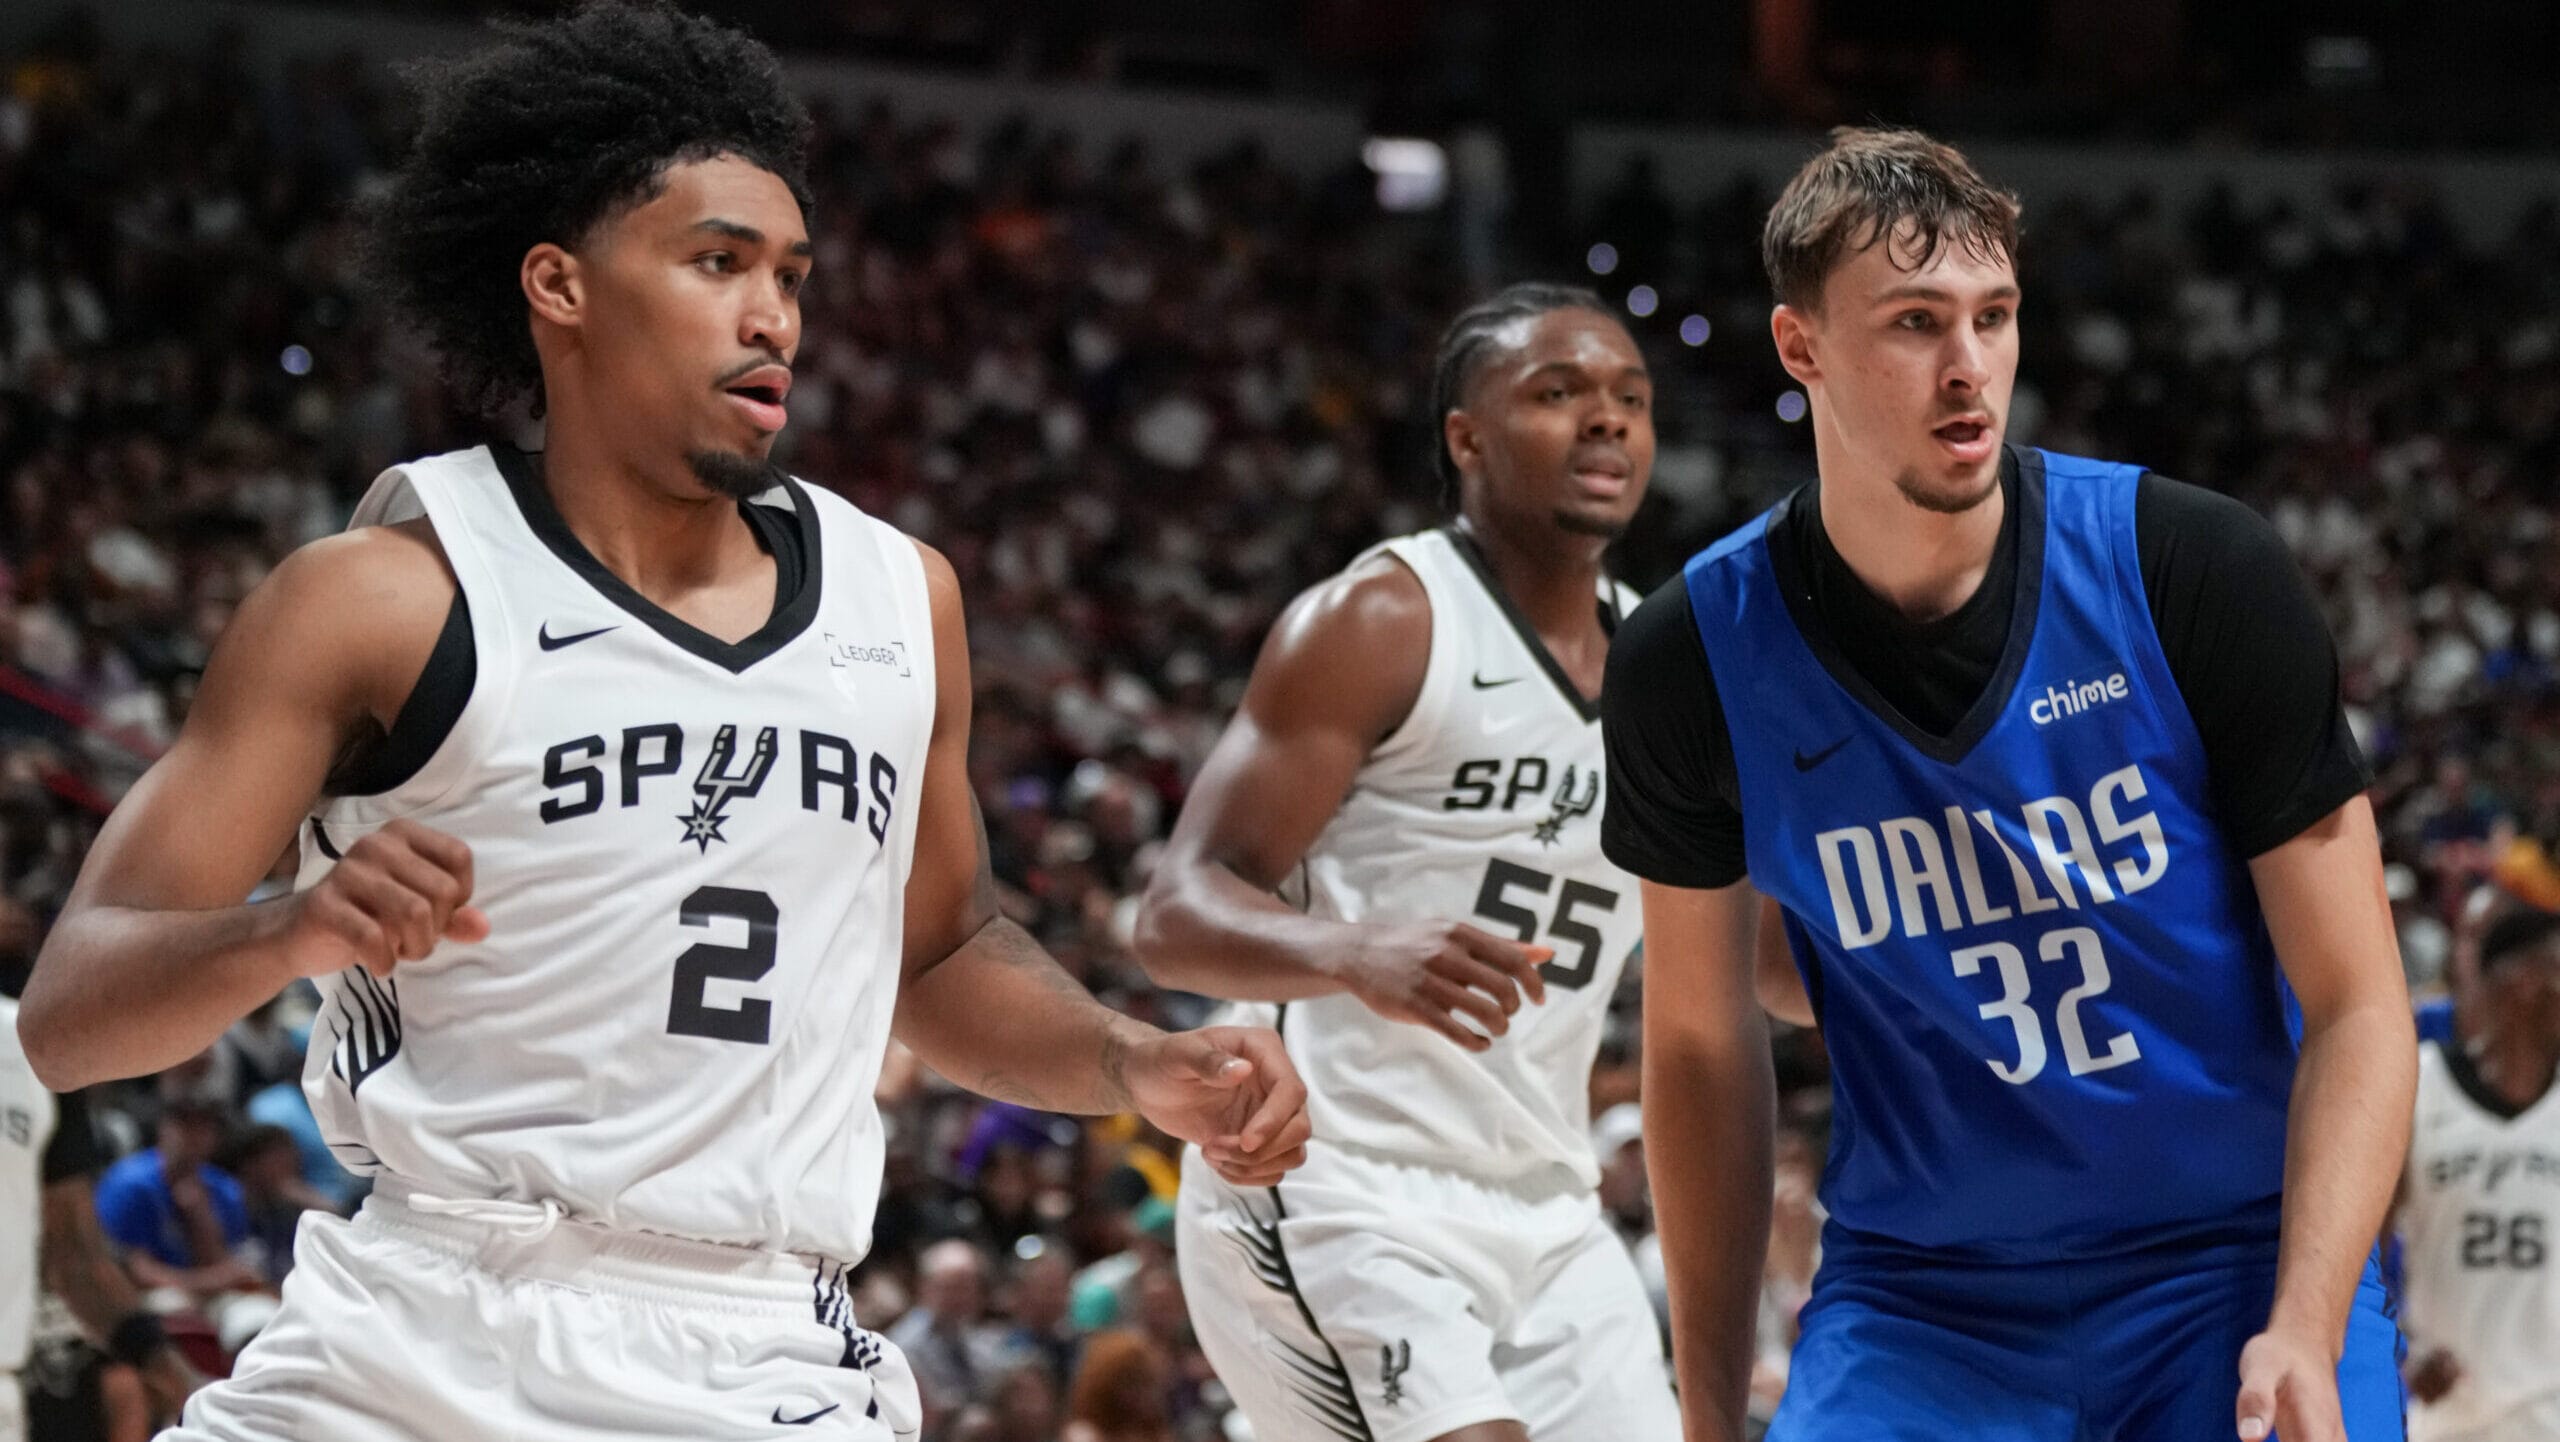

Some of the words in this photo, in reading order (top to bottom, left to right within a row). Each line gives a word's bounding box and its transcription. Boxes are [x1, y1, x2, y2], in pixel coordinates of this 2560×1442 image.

[838, 644, 898, 666] LEDGER
[2030, 672, 2128, 725] chime
[540, 722, 897, 854] SPURS
[1444, 758, 1599, 849] SPU
[1815, 764, 2169, 950] DALLAS
[666, 885, 780, 1045] 2
[1473, 857, 1619, 991] 55
[1951, 926, 2141, 1085] 32
[2462, 1213, 2545, 1269] 26
